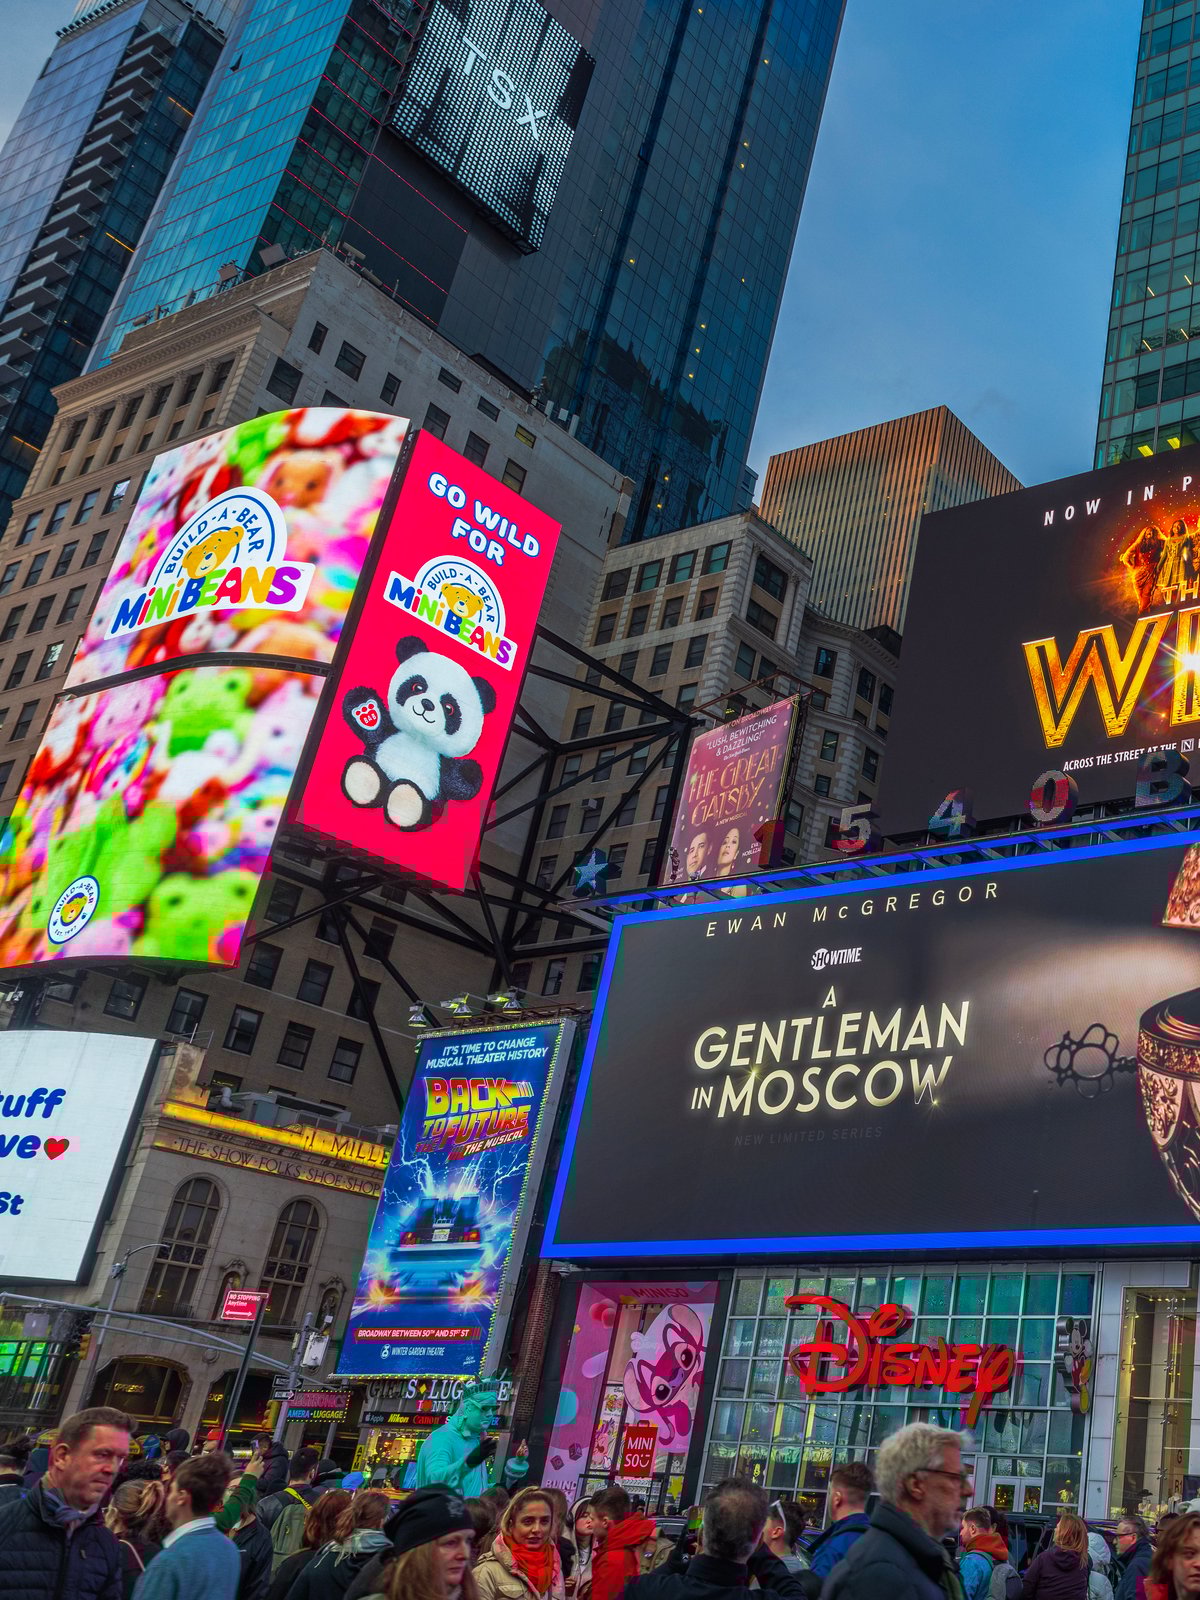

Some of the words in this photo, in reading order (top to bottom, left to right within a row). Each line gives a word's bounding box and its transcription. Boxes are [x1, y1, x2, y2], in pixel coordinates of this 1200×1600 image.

[463, 35, 547, 141] TSX
[428, 471, 467, 510] GO
[473, 500, 541, 558] WILD
[1043, 499, 1102, 527] NOW
[1126, 484, 1155, 506] IN
[451, 517, 506, 567] FOR
[177, 566, 302, 613] BEANS
[443, 608, 512, 665] BEANS
[740, 704, 775, 725] BROADWAY
[729, 714, 778, 743] BEWITCHING
[715, 747, 722, 757] &
[1063, 757, 1094, 772] ACROSS
[1096, 755, 1113, 766] THE
[1113, 749, 1146, 764] STREET
[688, 766, 719, 803] THE
[720, 743, 783, 790] GREAT
[691, 776, 766, 828] GATSBY
[731, 811, 748, 822] MUSICAL
[705, 911, 787, 937] EWAN
[811, 946, 863, 971] SHOWTIME
[822, 985, 838, 1009] A
[460, 1043, 482, 1055] TIME
[483, 1041, 497, 1053] TO
[497, 1036, 537, 1051] CHANGE
[693, 1000, 970, 1070] GENTLEMAN
[425, 1055, 464, 1070] MUSICAL
[465, 1052, 507, 1066] THEATER
[506, 1046, 550, 1061] HISTORY
[424, 1076, 534, 1117] BACK
[690, 1085, 714, 1110] IN
[717, 1055, 954, 1119] MOSCOW
[0, 1087, 67, 1119] uff
[422, 1117, 444, 1139] TO
[440, 1104, 532, 1150] FUTURE
[734, 1134, 763, 1146] NEW
[769, 1129, 825, 1144] LIMITED
[831, 1126, 884, 1141] SERIES
[463, 1141, 483, 1157] THE
[485, 1129, 524, 1149] MUSICAL
[178, 1136, 208, 1157] THE
[209, 1144, 254, 1167] SHOW
[257, 1156, 302, 1179] FOLKS
[304, 1167, 343, 1187] SHOE
[345, 1176, 383, 1197] SHOP
[228, 1293, 238, 1301] NO
[237, 1294, 261, 1302] STOPPING
[630, 1287, 689, 1299] MINISO
[357, 1329, 392, 1338] BROADWAY
[391, 1329, 422, 1338] BETWEEN
[434, 1329, 450, 1337] AND
[408, 1346, 427, 1356] GARDEN
[426, 1346, 445, 1357] THEATRE
[427, 1378, 512, 1401] LUGE
[286, 1409, 310, 1419] AMERA
[312, 1409, 344, 1419] LUGGAGE
[369, 1414, 385, 1423] Apple
[387, 1413, 410, 1424] Nikon
[412, 1415, 441, 1425] Canon
[431, 1400, 450, 1413] NY
[626, 1436, 654, 1450] MINI
[352, 1445, 364, 1471] ATM
